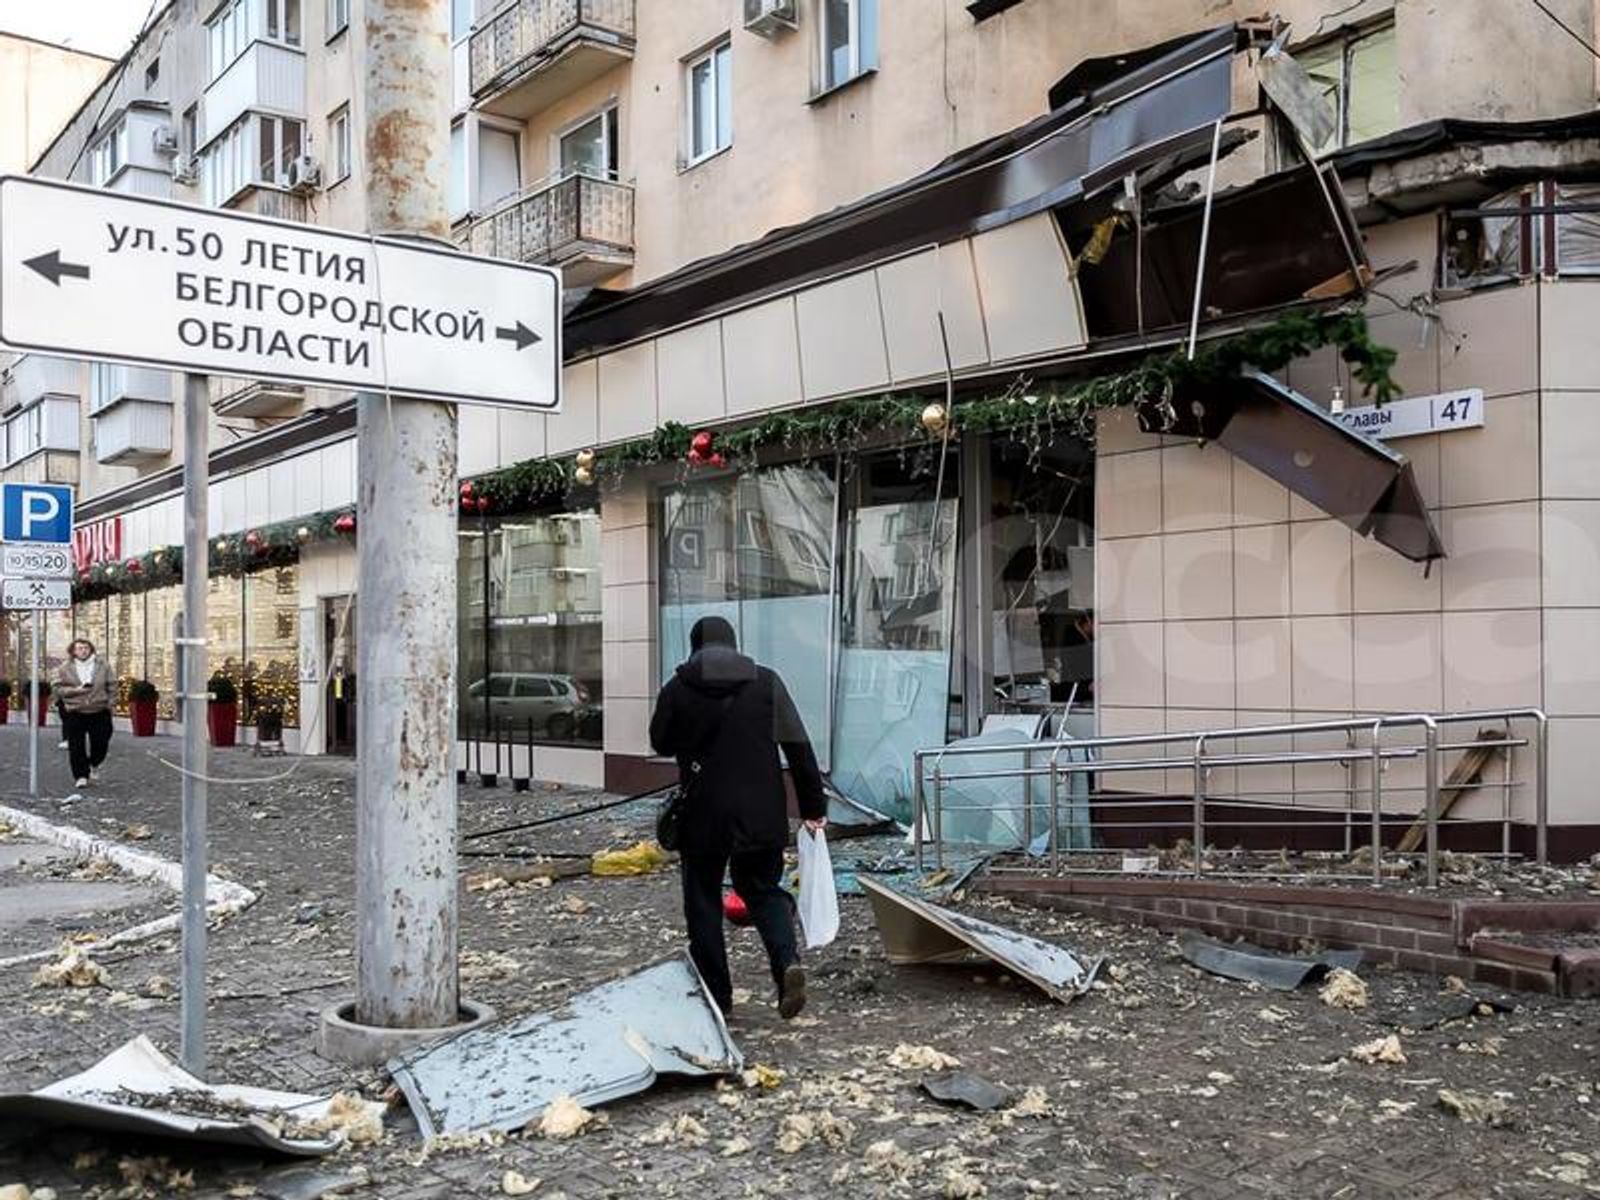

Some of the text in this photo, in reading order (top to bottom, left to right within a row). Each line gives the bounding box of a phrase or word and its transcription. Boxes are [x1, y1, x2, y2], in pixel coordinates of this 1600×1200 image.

[240, 238, 366, 285] ЛЕТИЯ
[176, 271, 484, 343] БЕЛГОРОДСКОЙ
[177, 317, 370, 368] ОБЛАСТИ
[1440, 397, 1471, 422] 47
[44, 555, 64, 569] 20
